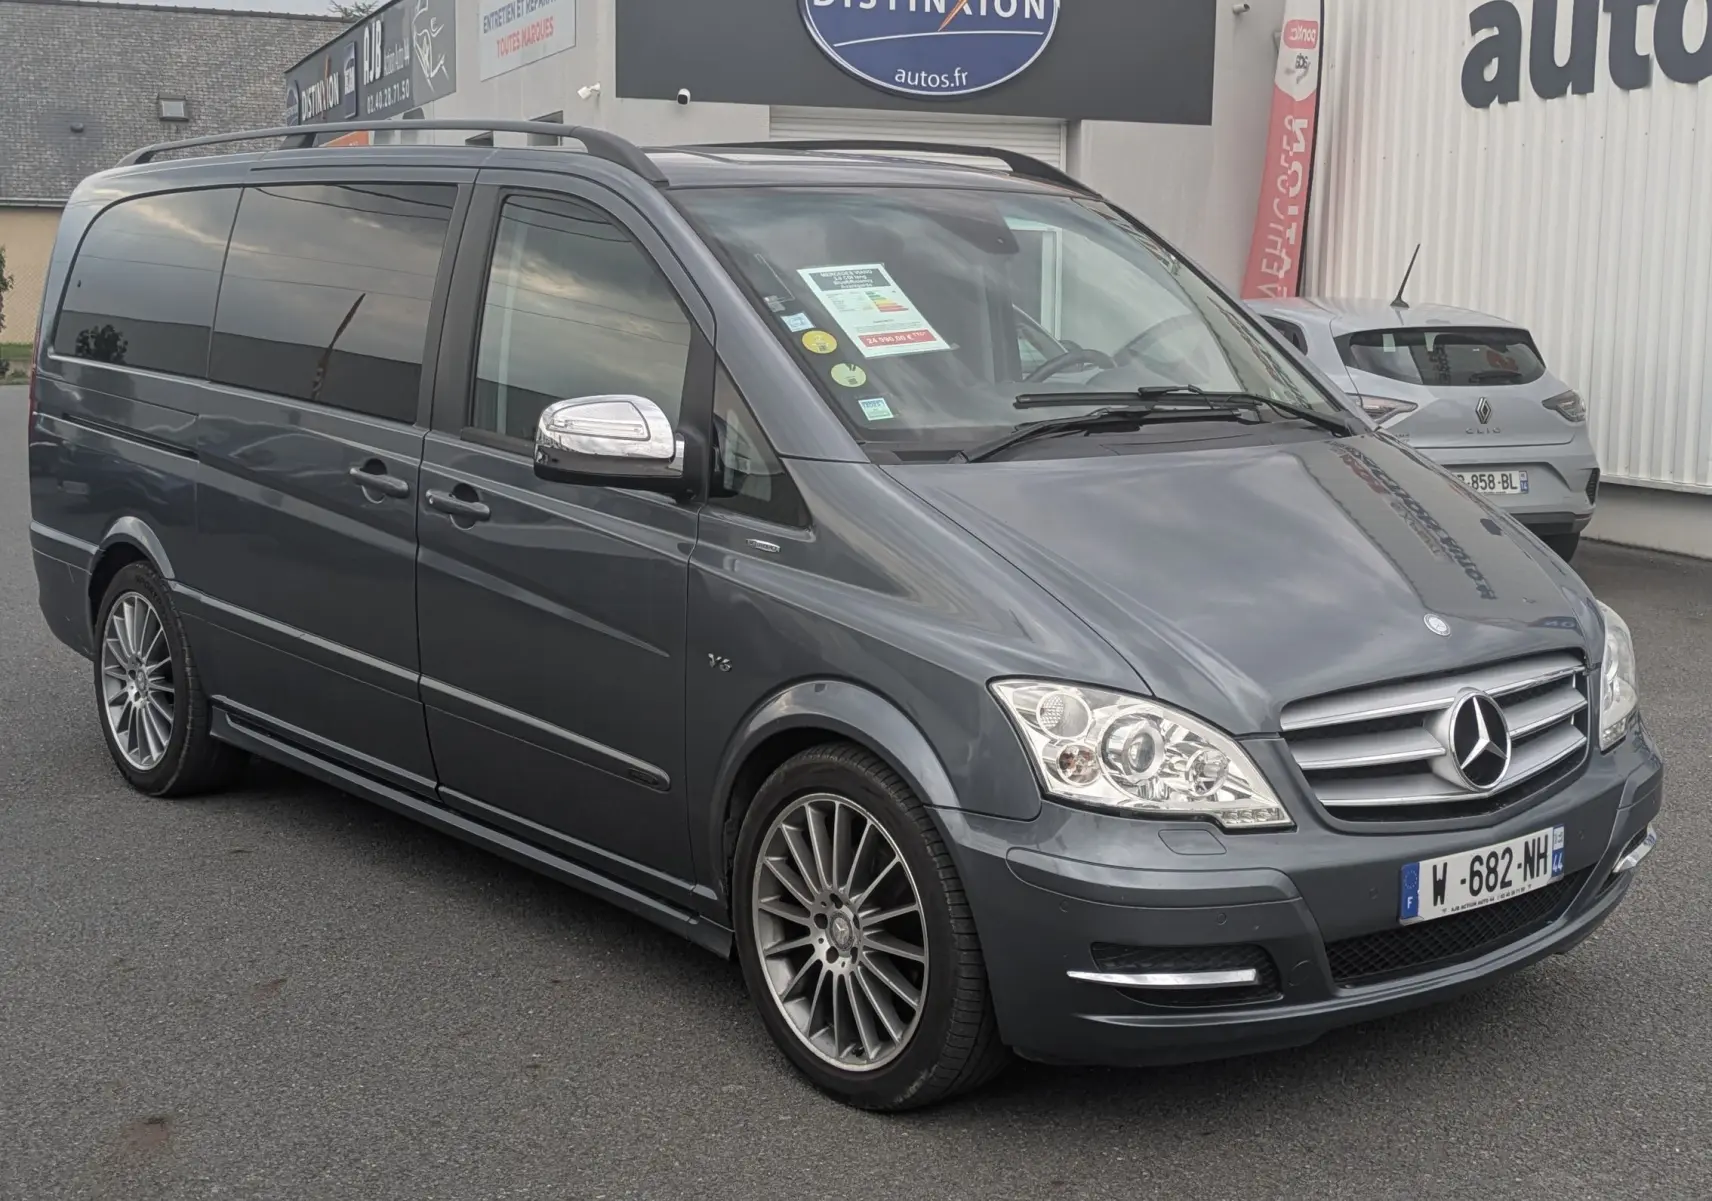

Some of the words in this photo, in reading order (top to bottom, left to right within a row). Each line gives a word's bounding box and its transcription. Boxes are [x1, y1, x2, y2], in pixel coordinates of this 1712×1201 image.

[483, 2, 516, 34] ENTRETIEN
[813, 0, 1045, 20] NXION
[363, 19, 382, 85] AJB
[497, 30, 520, 58] TOUTES
[521, 16, 554, 47] MARQUES
[894, 67, 968, 88] autos.fr
[708, 652, 732, 672] V6
[1407, 896, 1413, 909] F
[1552, 852, 1563, 872] 44
